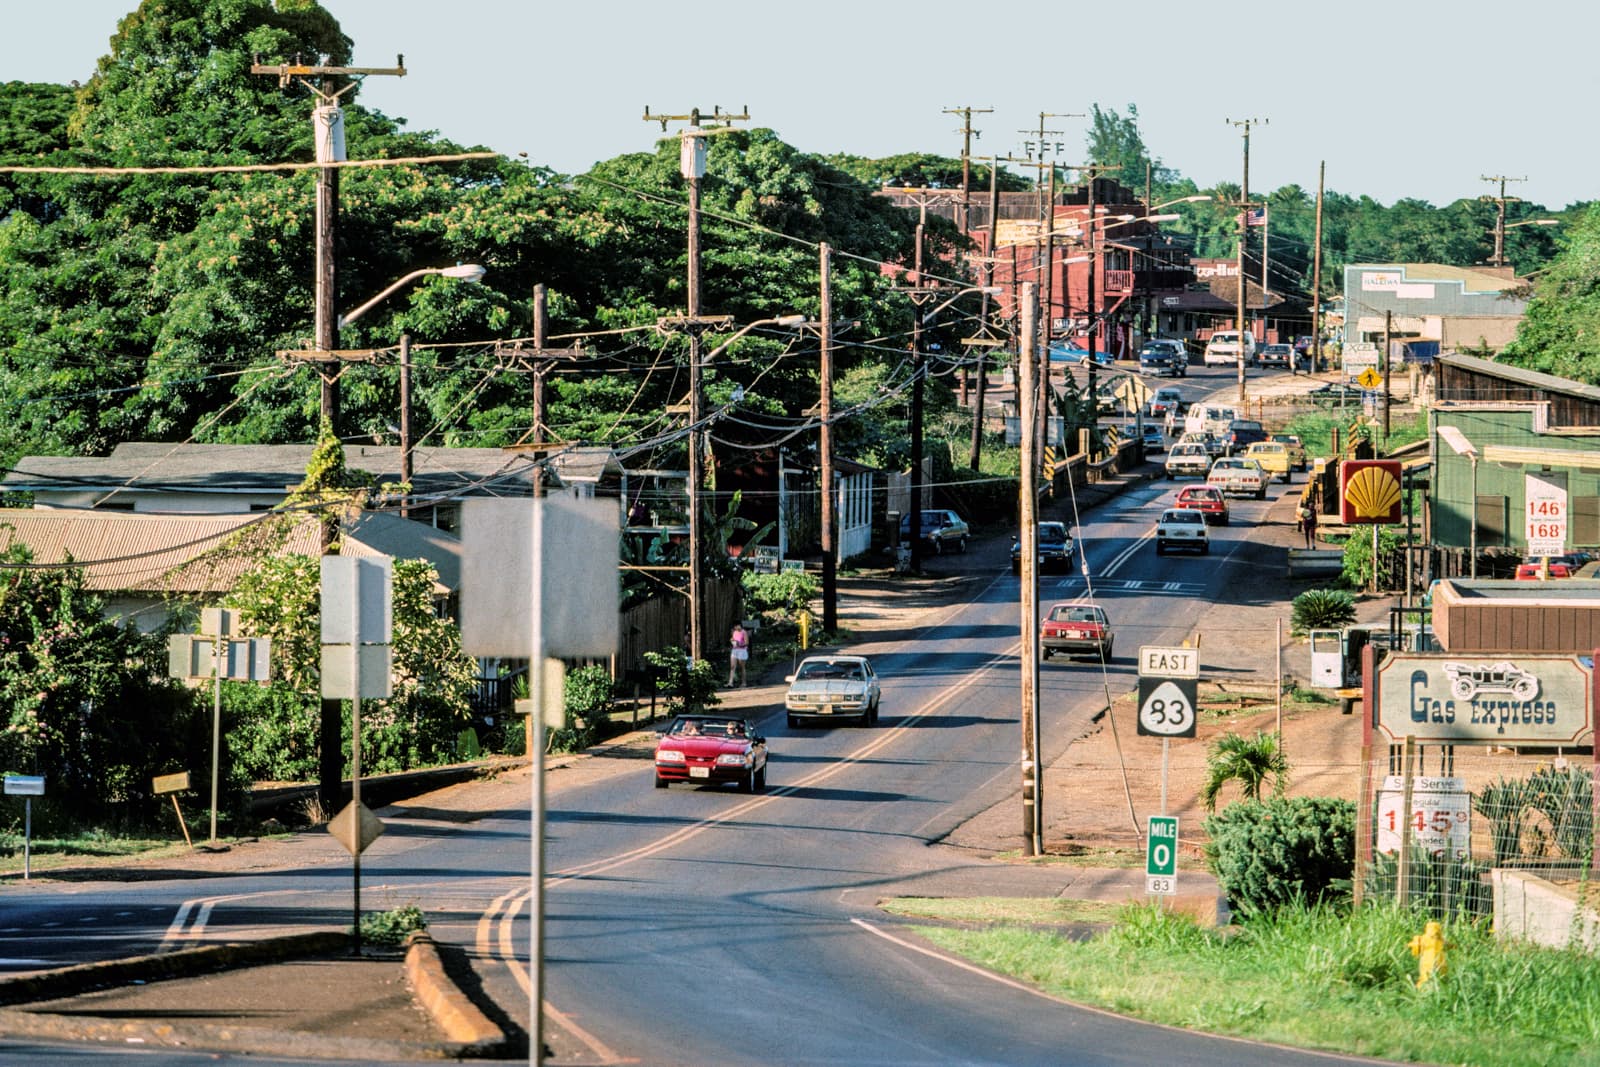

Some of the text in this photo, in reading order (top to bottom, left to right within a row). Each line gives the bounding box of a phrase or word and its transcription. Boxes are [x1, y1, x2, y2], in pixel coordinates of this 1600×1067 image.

[1530, 501, 1559, 515] 146
[1530, 523, 1559, 538] 168
[1149, 653, 1190, 670] EAST
[1410, 669, 1556, 734] Gas Express
[1150, 699, 1185, 725] 83
[1421, 778, 1455, 789] Serve
[1413, 799, 1441, 807] egular
[1151, 822, 1175, 838] MILE
[1153, 844, 1170, 866] 0
[1153, 880, 1169, 891] 83
